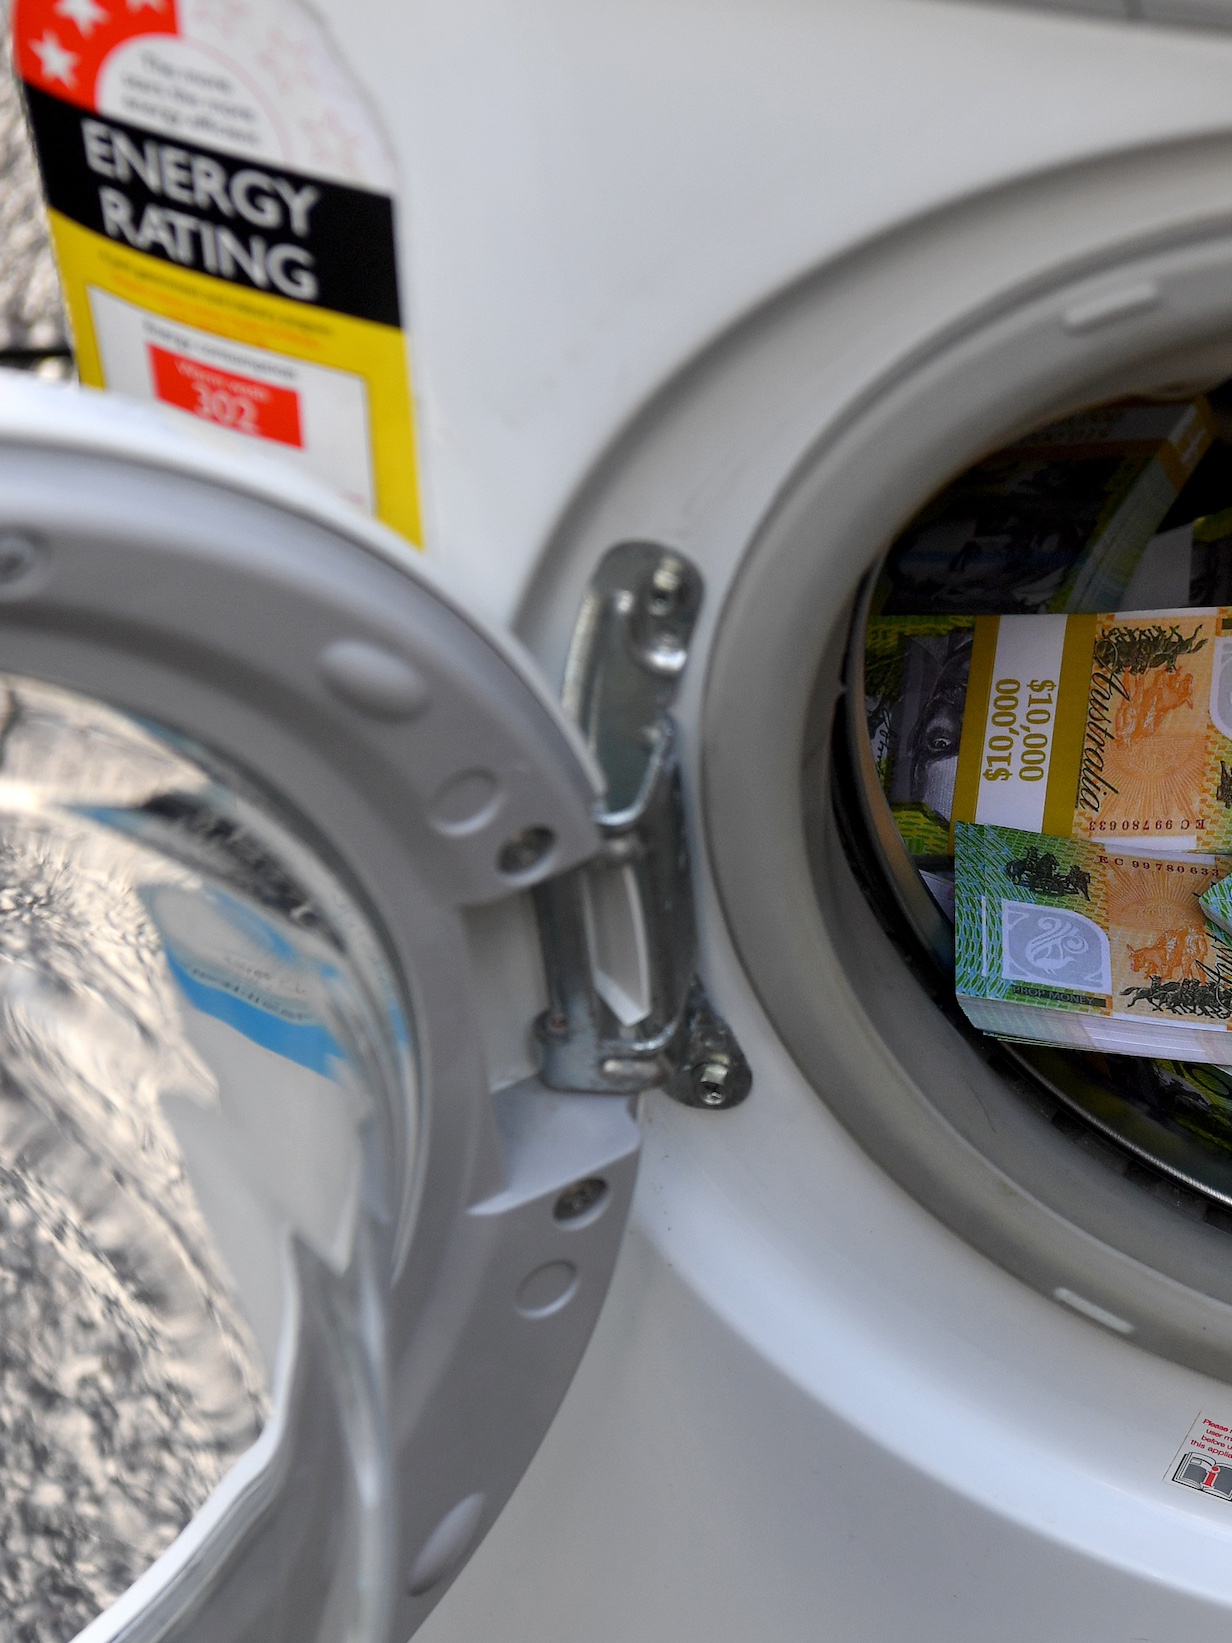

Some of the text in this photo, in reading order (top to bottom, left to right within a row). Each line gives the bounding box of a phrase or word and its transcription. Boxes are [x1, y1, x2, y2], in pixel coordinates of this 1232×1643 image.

[82, 117, 319, 237] ENERGY
[100, 186, 319, 302] RATING
[191, 379, 260, 435] 302
[983, 679, 1020, 781] $10,000
[1019, 679, 1056, 782] $10,000
[1079, 645, 1130, 813] Australia
[1012, 985, 1095, 1005] PROP MONEY
[1190, 1439, 1206, 1449] this
[1201, 1435, 1225, 1448] before
[1203, 1418, 1228, 1432] Please
[1206, 1429, 1224, 1439] user
